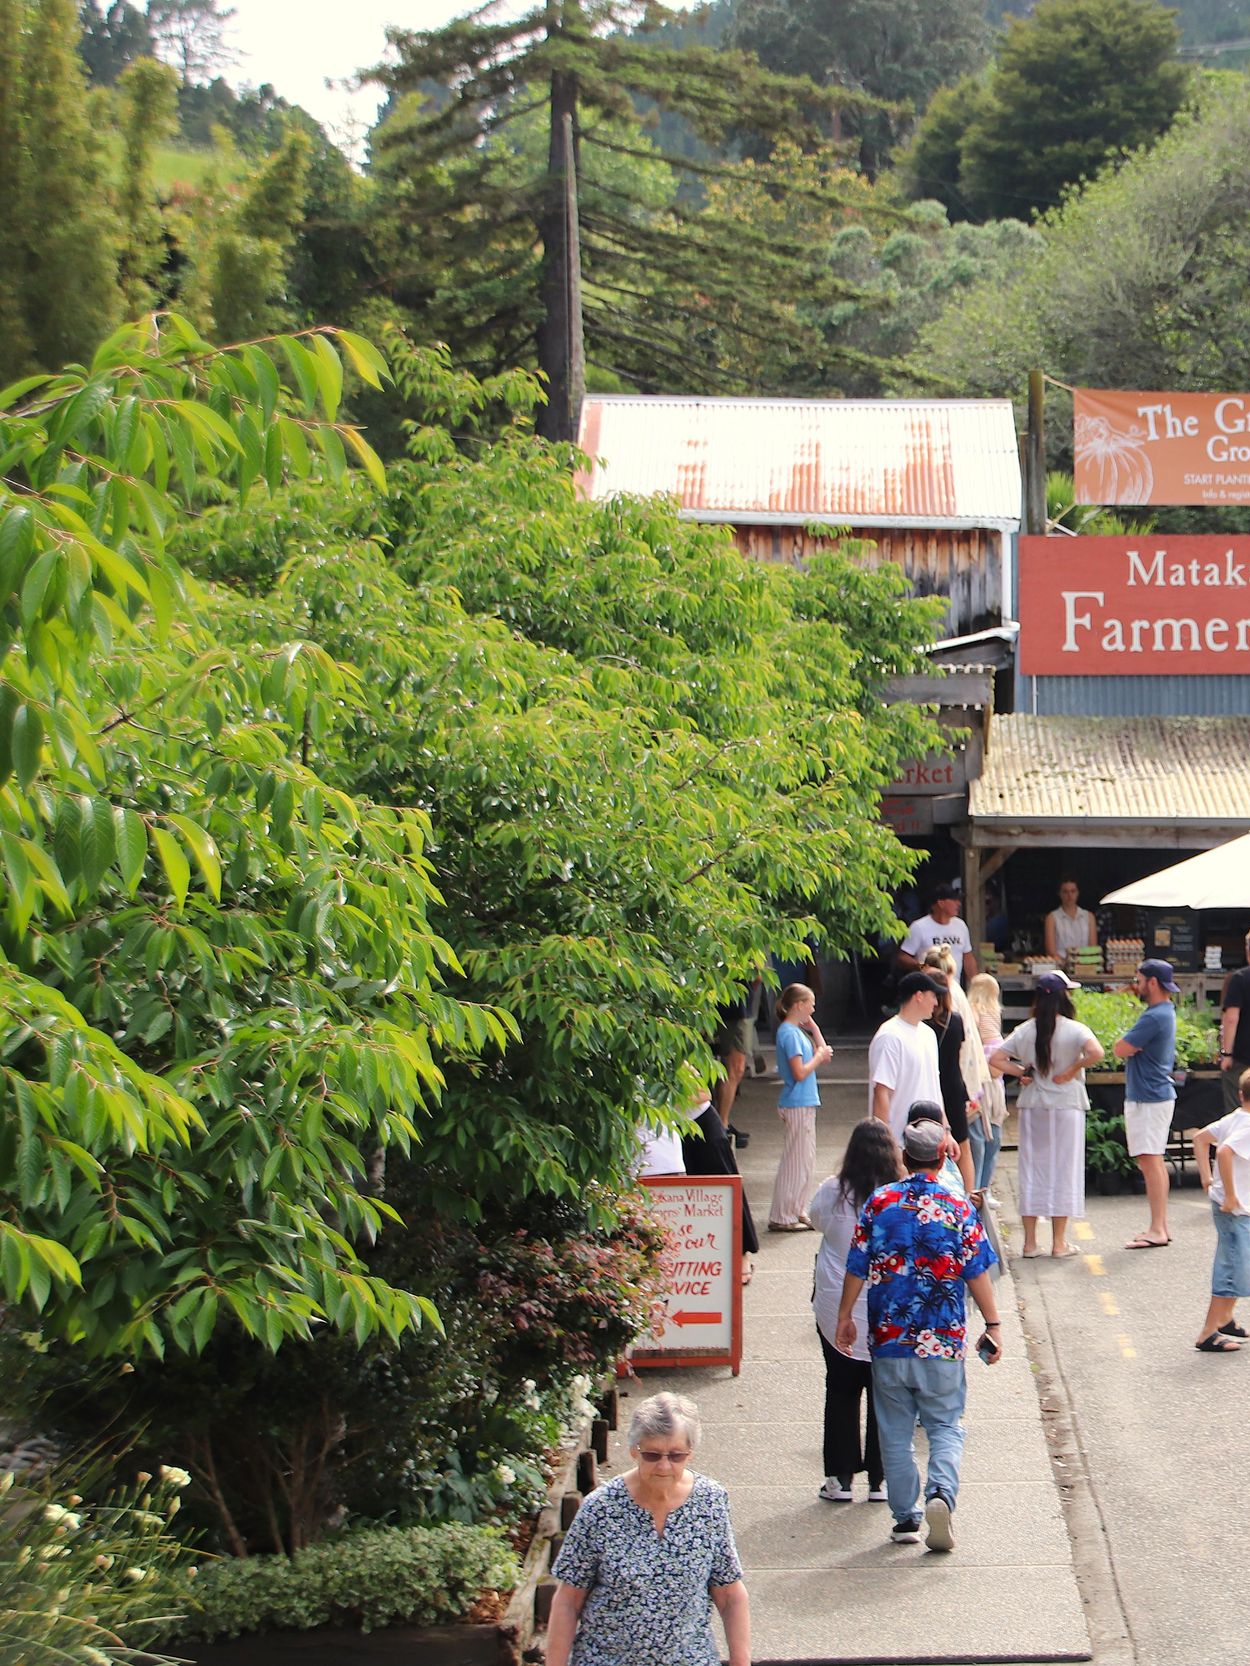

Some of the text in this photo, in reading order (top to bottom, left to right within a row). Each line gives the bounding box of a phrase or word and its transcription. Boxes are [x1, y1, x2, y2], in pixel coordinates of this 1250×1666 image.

[1138, 404, 1199, 441] The
[1183, 473, 1213, 486] START
[685, 1189, 724, 1207] Village
[684, 1203, 724, 1217] Market
[672, 1281, 712, 1296] VICE
